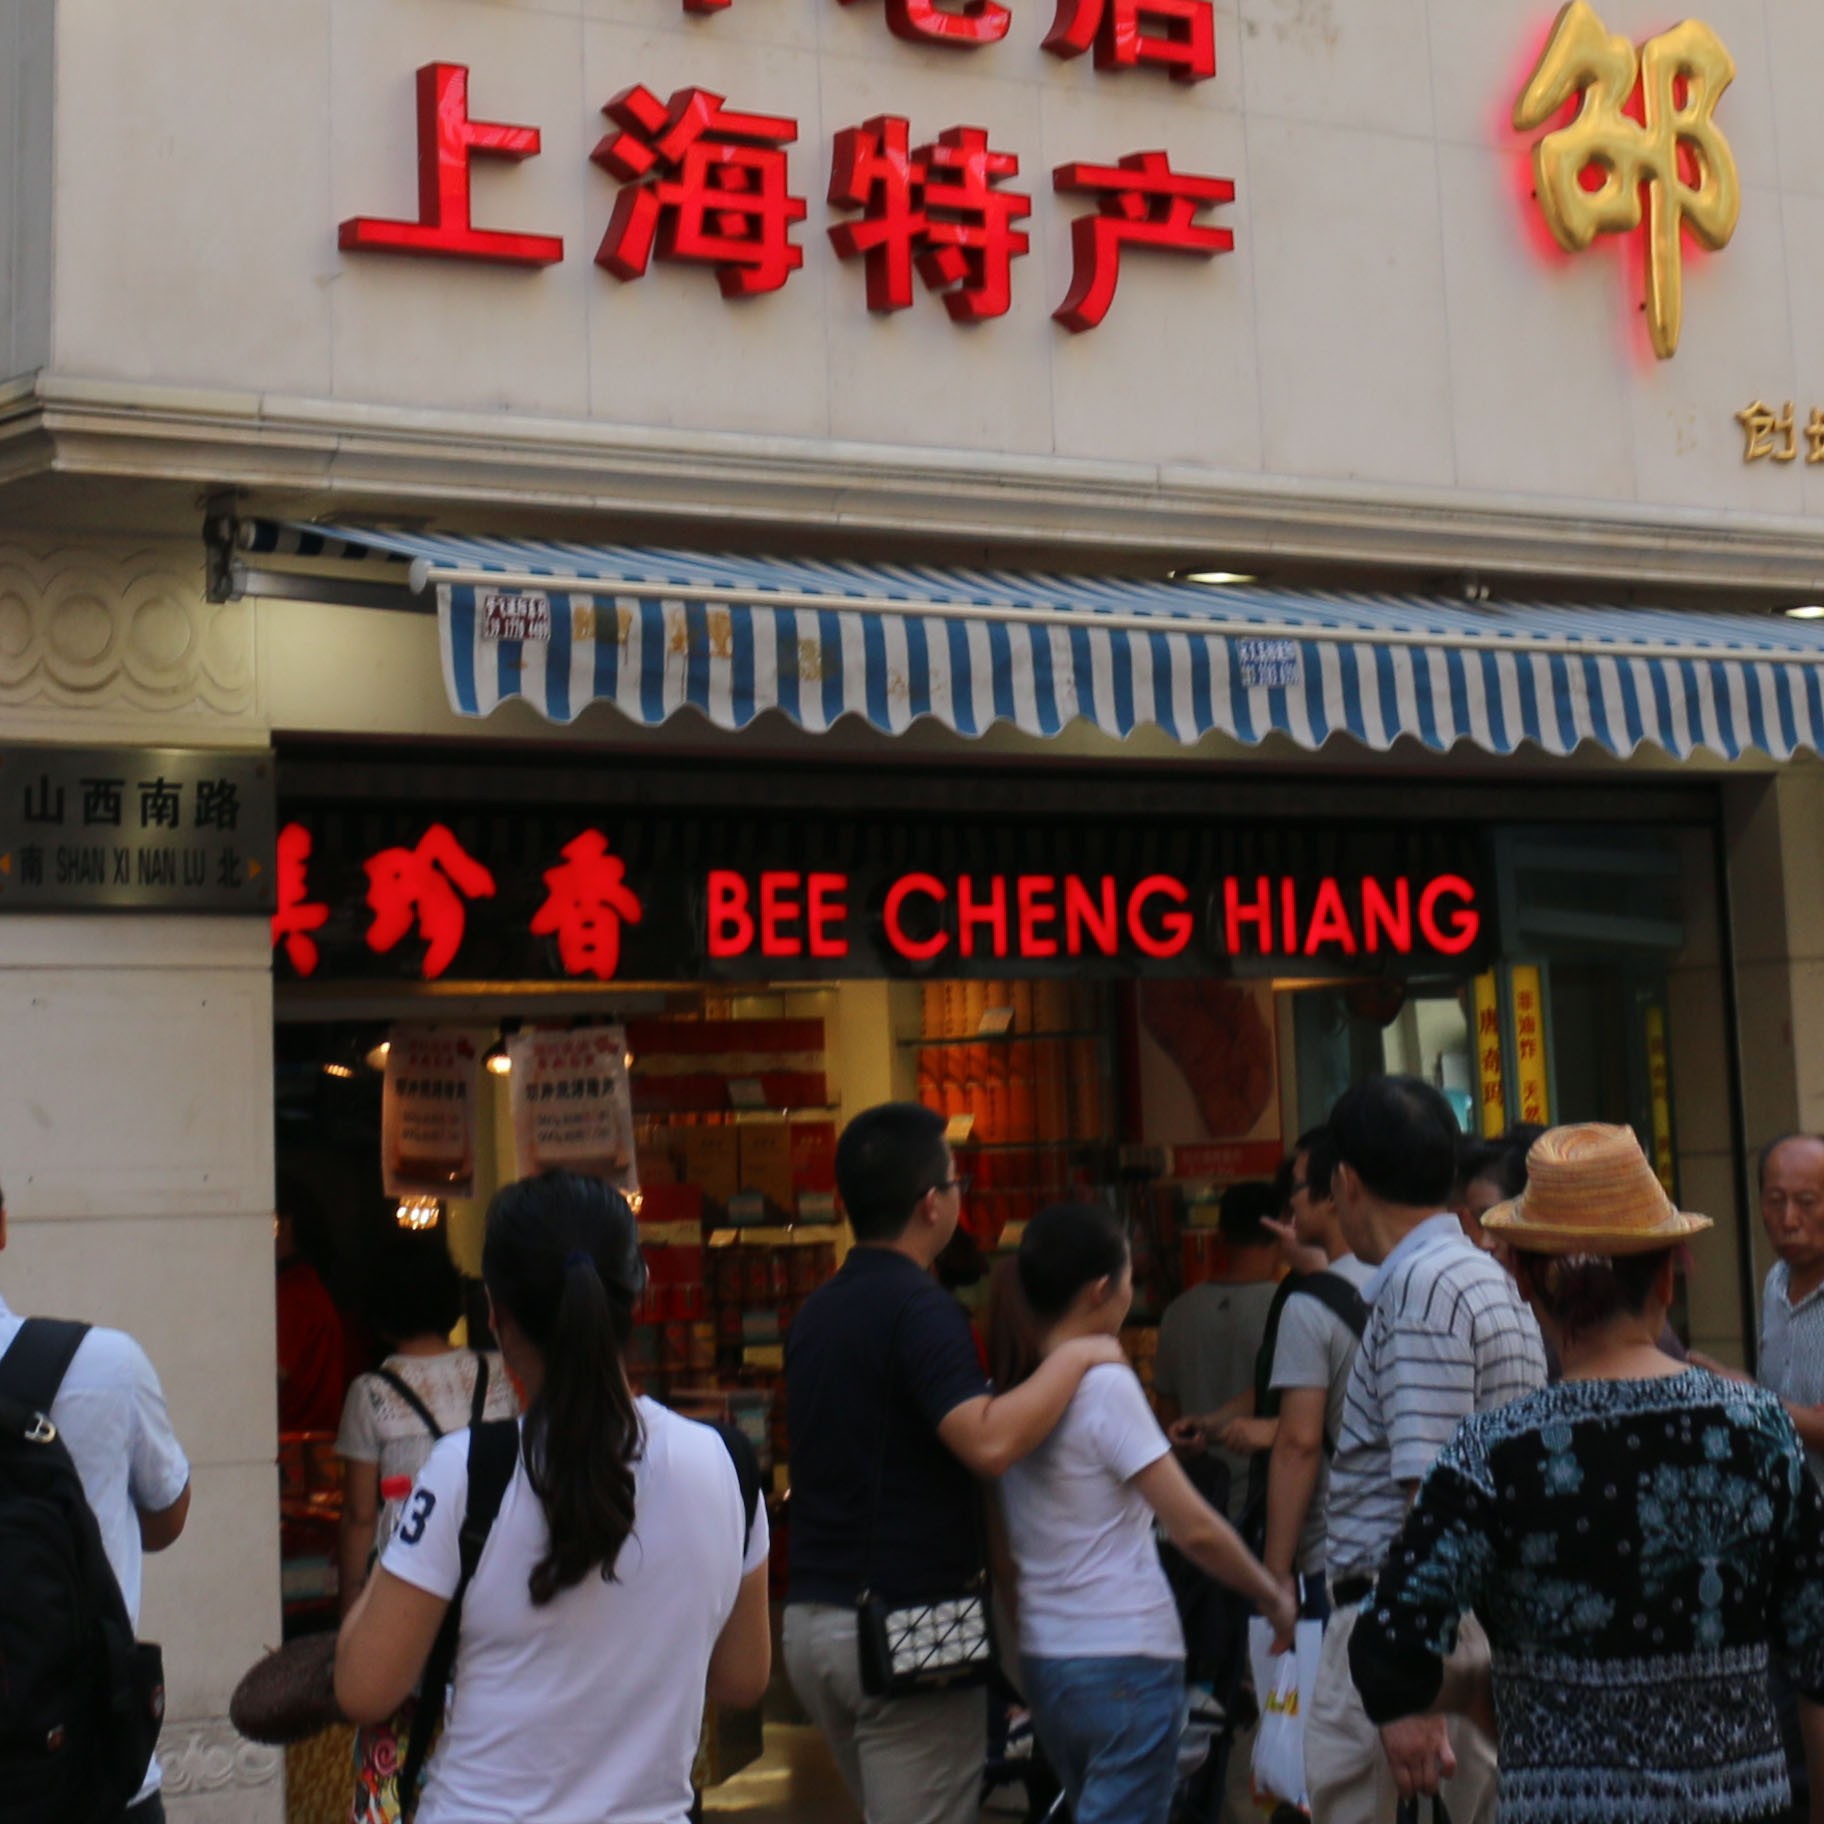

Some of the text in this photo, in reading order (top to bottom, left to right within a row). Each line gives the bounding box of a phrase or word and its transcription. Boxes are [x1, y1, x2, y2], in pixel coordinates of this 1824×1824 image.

[338, 61, 1236, 336] 上海特产
[23, 774, 241, 832] 山西南路
[19, 844, 242, 888] 南 SHAN XI NAN LU 北
[706, 869, 851, 959] BEE
[884, 869, 1195, 961] CHENG
[1222, 872, 1482, 956] HIANG
